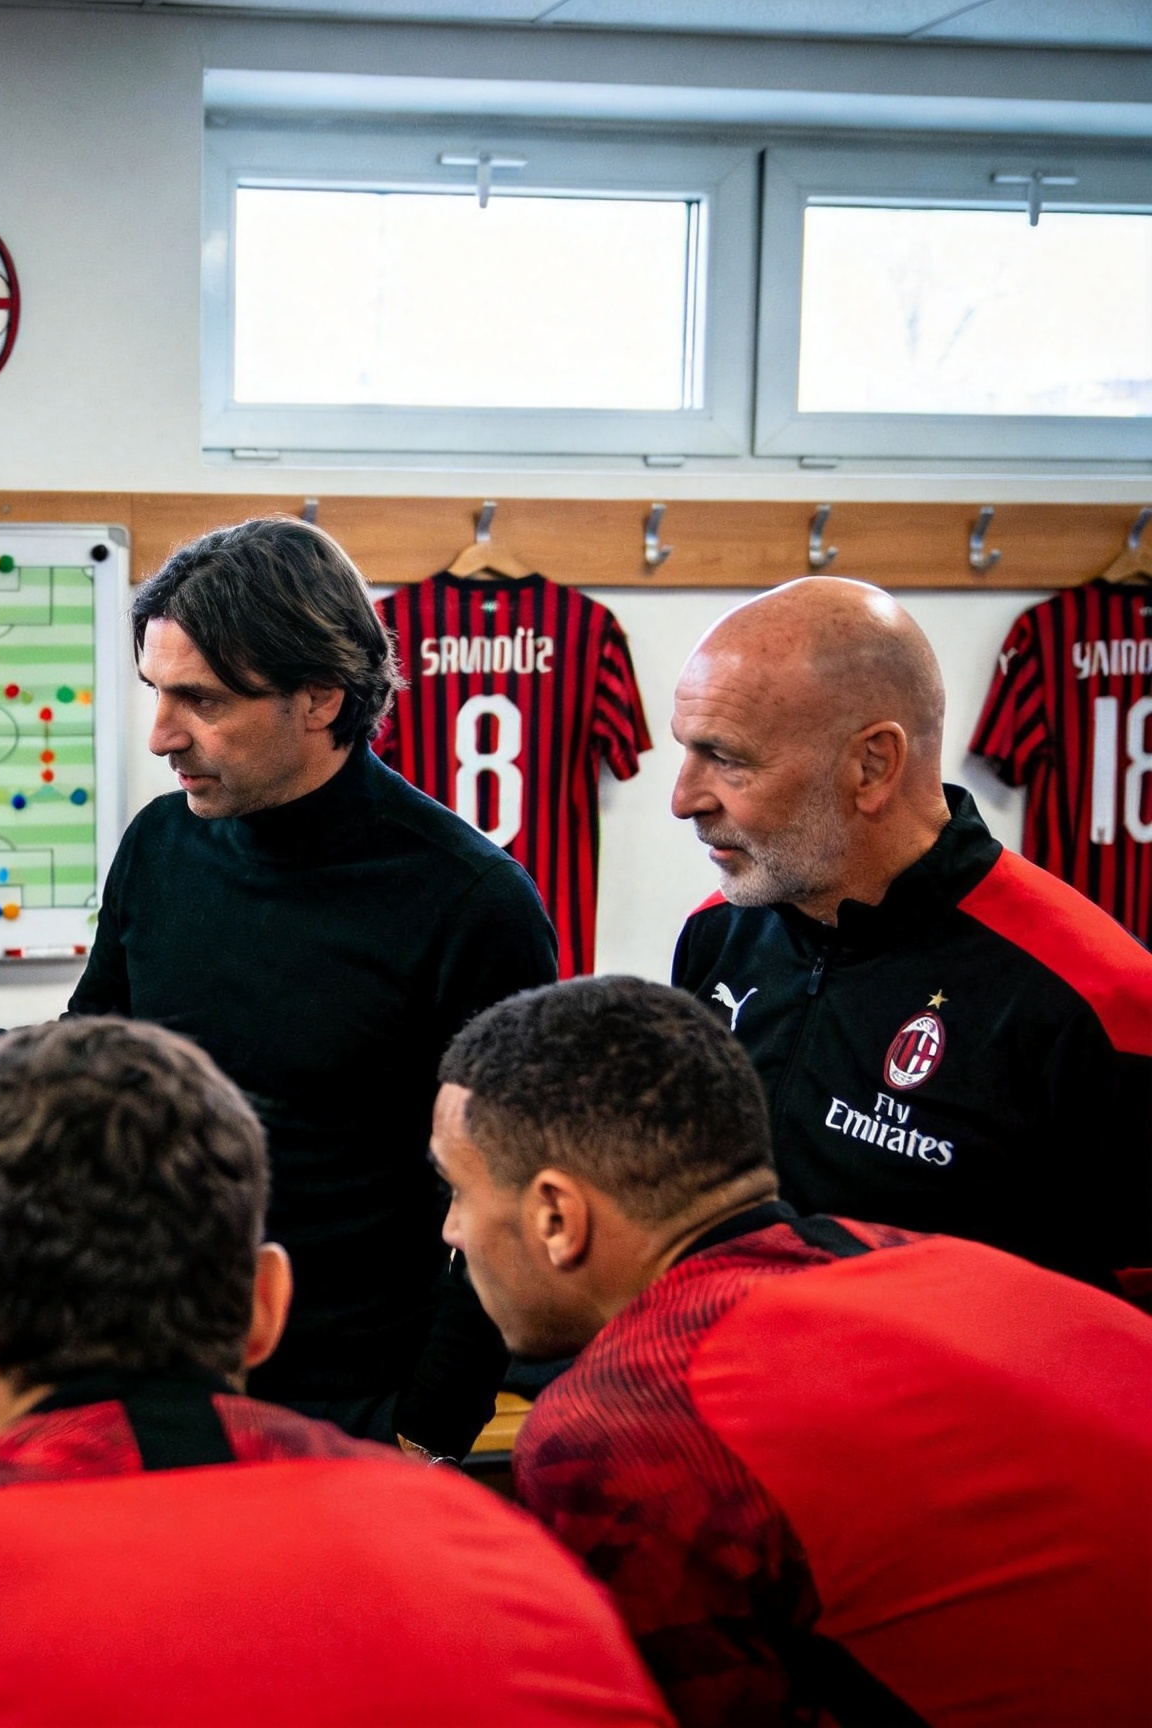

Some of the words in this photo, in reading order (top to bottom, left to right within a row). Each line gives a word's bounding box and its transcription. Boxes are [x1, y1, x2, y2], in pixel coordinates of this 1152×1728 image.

[455, 694, 523, 848] 8
[825, 1096, 954, 1166] Emirates
[874, 1092, 910, 1124] Fly
